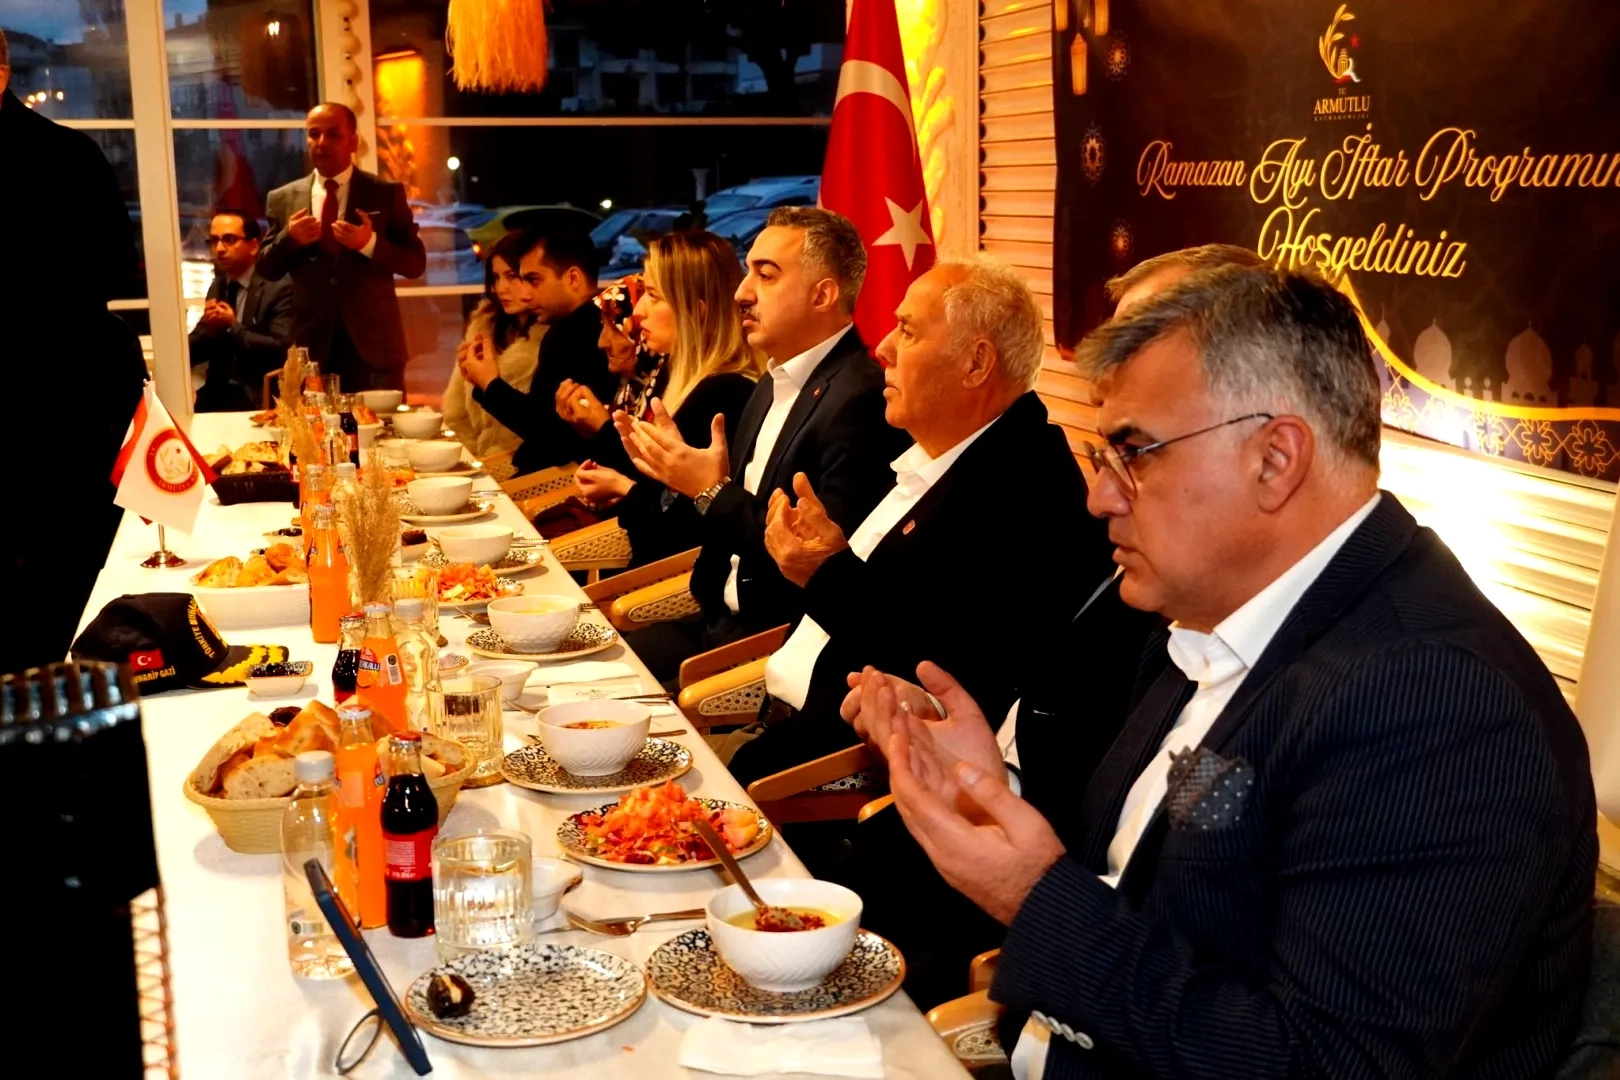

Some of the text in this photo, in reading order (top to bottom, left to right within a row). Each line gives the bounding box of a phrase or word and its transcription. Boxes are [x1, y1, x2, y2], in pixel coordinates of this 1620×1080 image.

[1313, 95, 1371, 114] ARMUTLU
[1137, 140, 1247, 200] Ramazan
[1250, 136, 1316, 209] Ayı
[1320, 122, 1410, 200] İftar
[1257, 205, 1467, 283] Hoşgeldiniz
